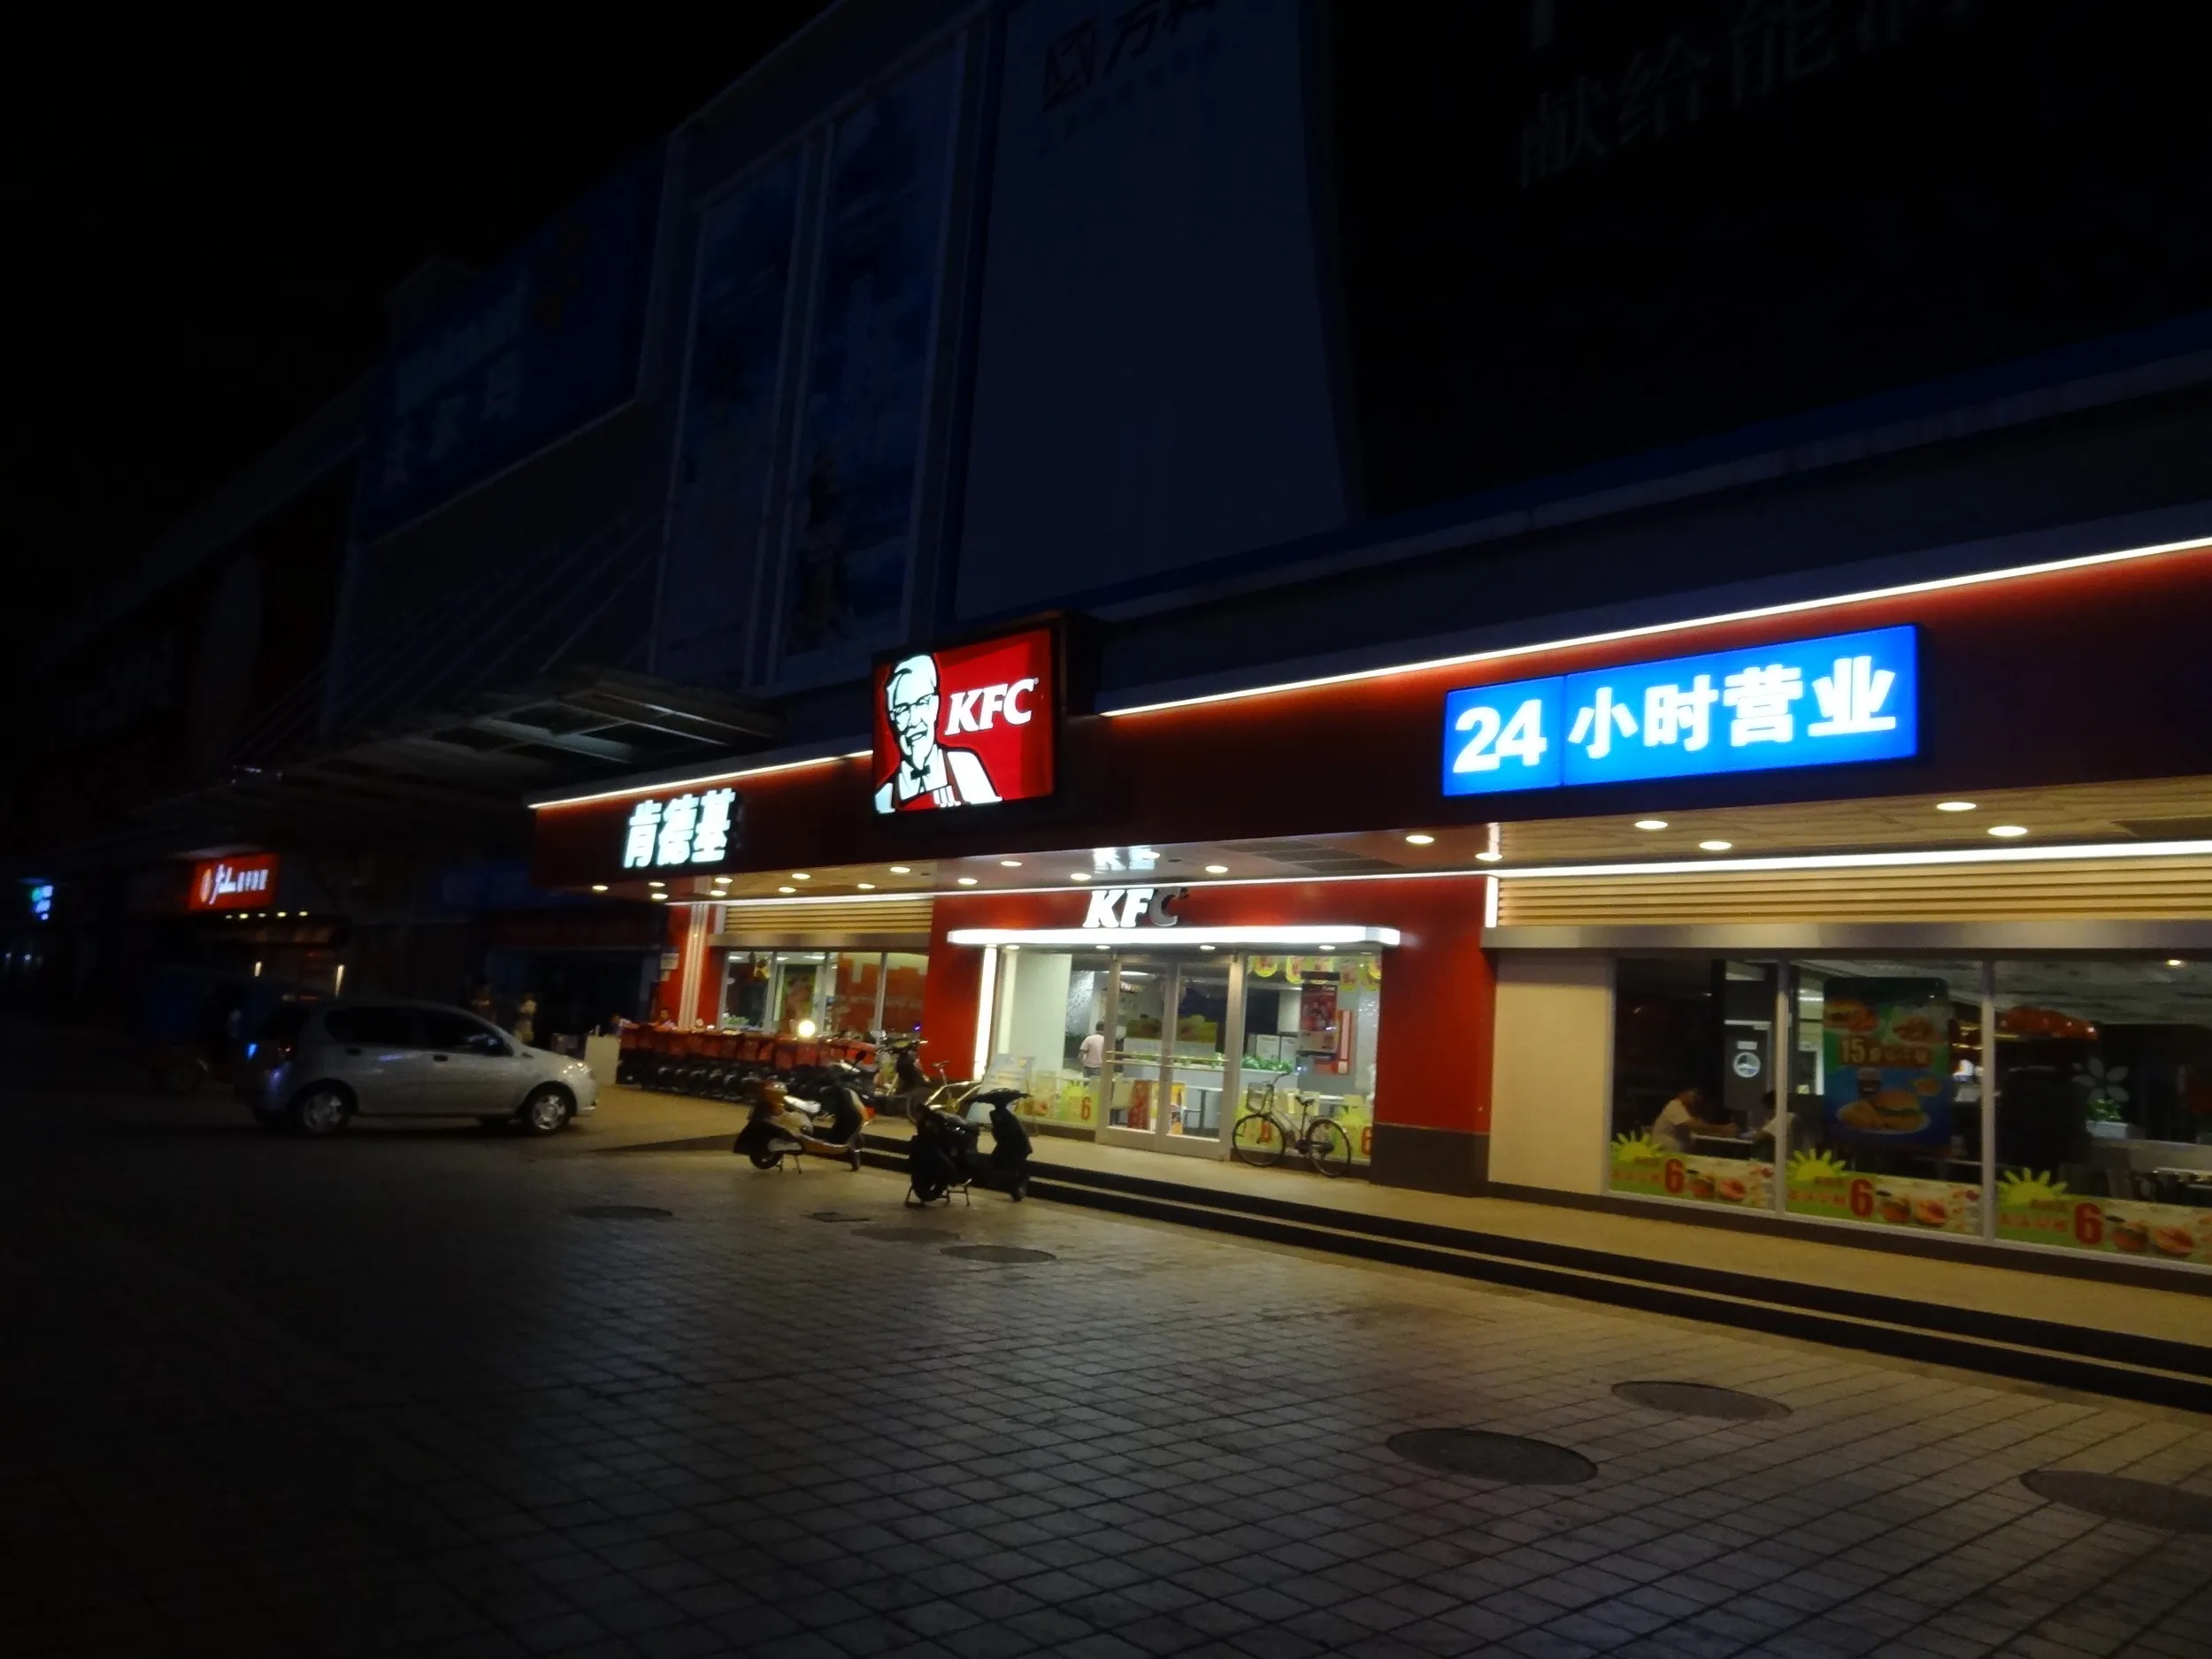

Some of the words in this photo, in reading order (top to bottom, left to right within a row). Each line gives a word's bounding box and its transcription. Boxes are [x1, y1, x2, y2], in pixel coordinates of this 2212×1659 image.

[944, 677, 1040, 736] KFC
[1453, 699, 1548, 773] 24
[1567, 655, 1896, 760] 小时营业
[625, 787, 735, 868] 肯德基
[1081, 887, 1187, 928] KFC
[1664, 1158, 1685, 1194] 6
[1850, 1179, 1874, 1218] 6
[2074, 1202, 2102, 1244] 6
